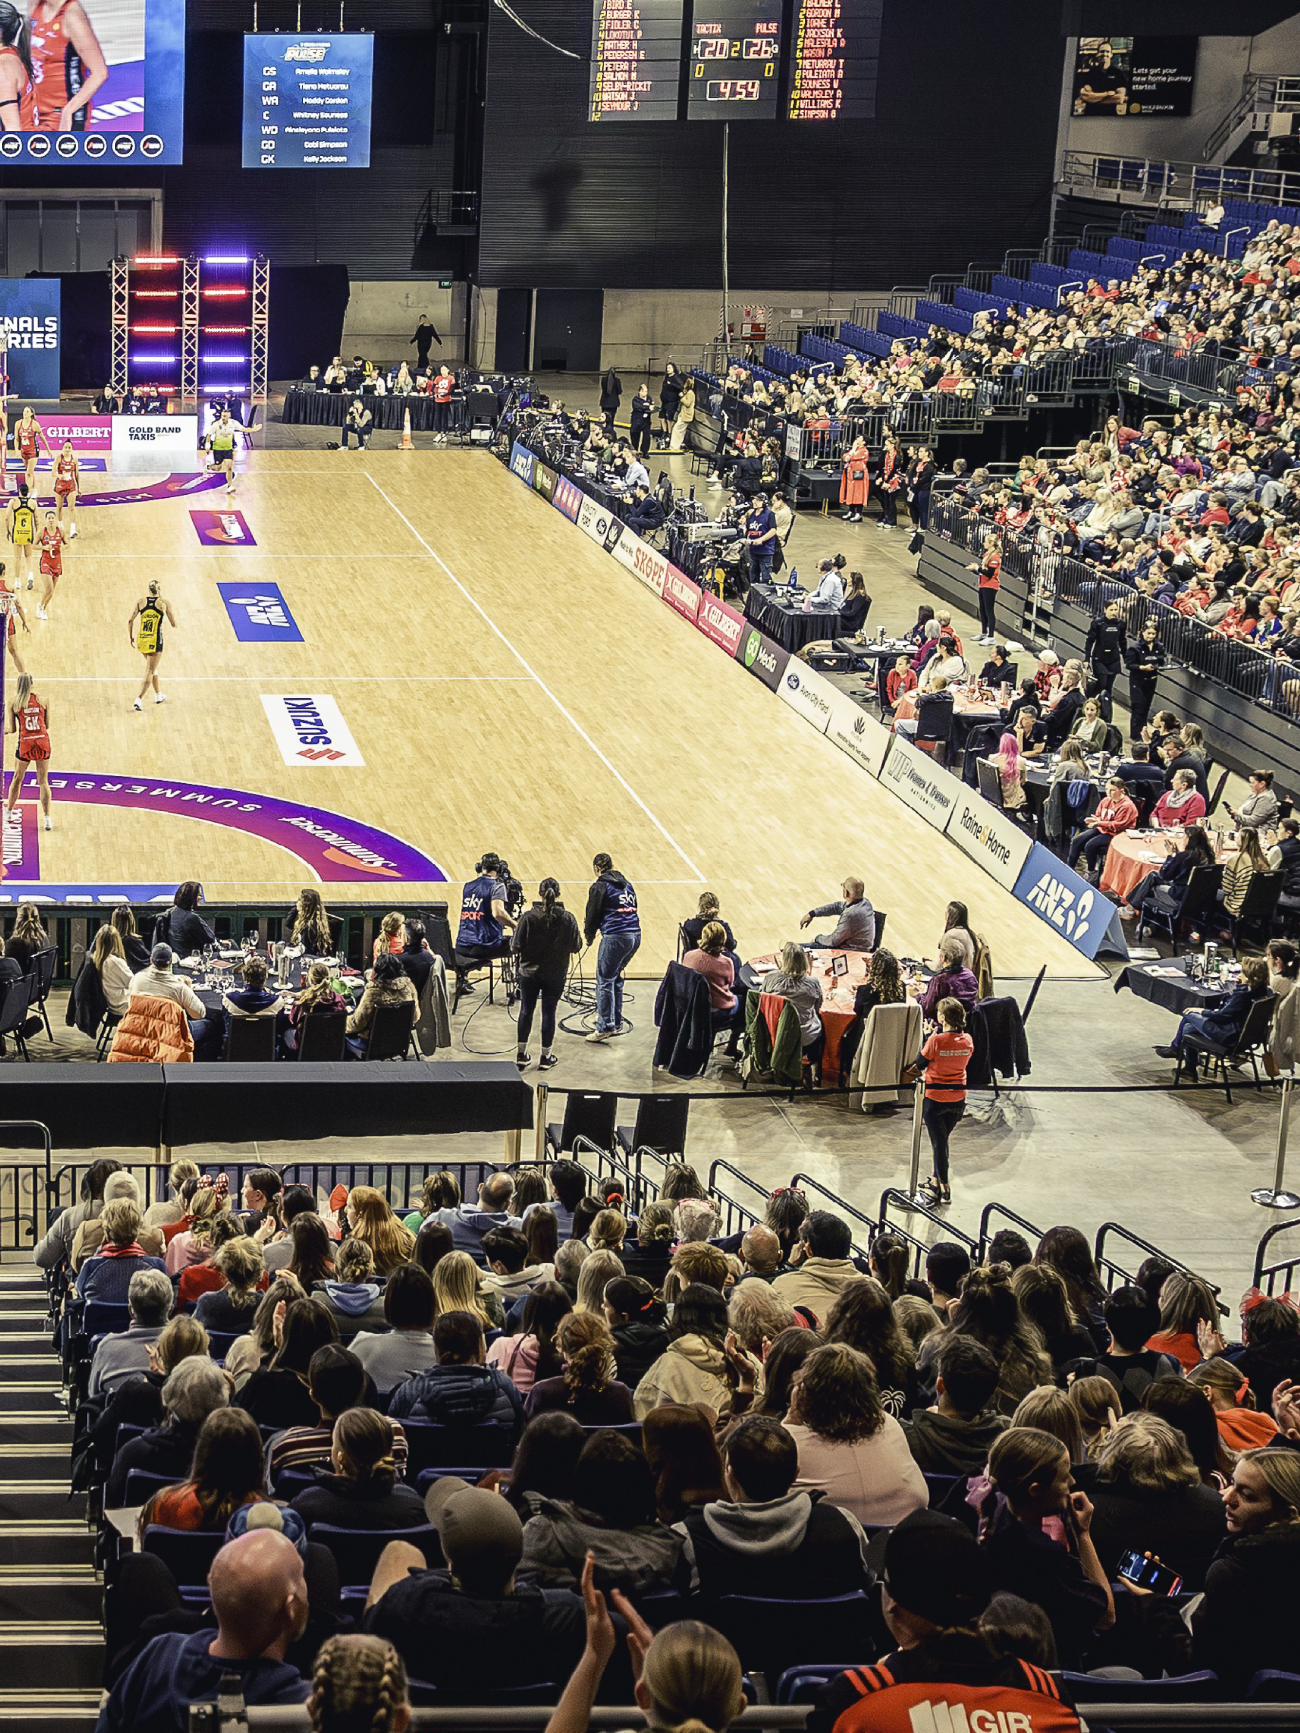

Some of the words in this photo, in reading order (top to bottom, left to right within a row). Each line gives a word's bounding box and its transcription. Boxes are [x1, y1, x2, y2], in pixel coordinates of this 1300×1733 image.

[696, 24, 722, 34] TACTIX
[755, 22, 778, 34] PULSE
[285, 48, 326, 61] PULSE
[705, 40, 726, 56] 20
[730, 42, 740, 56] 2
[750, 40, 771, 56] 26
[262, 67, 276, 76] GS
[694, 64, 704, 77] 0
[764, 62, 774, 76] 0
[262, 82, 277, 91] GA
[262, 96, 278, 106] WA
[262, 111, 270, 120] C
[262, 126, 278, 134] WD
[261, 140, 276, 150] GD
[261, 154, 275, 164] GK
[47, 427, 112, 438] GILBERT
[128, 426, 154, 434] GOLD
[155, 426, 182, 434] BAND
[633, 547, 665, 588] SKOPE
[746, 638, 760, 657] GO
[756, 645, 778, 672] Media
[25, 716, 40, 731] GK
[283, 698, 332, 745] SUZUKI
[887, 748, 913, 783] VIP
[23, 779, 262, 813] SUMMERSET
[278, 816, 398, 868] Summerset
[463, 893, 484, 910] sky
[618, 890, 636, 906] sky
[1026, 873, 1076, 928] ANZ
